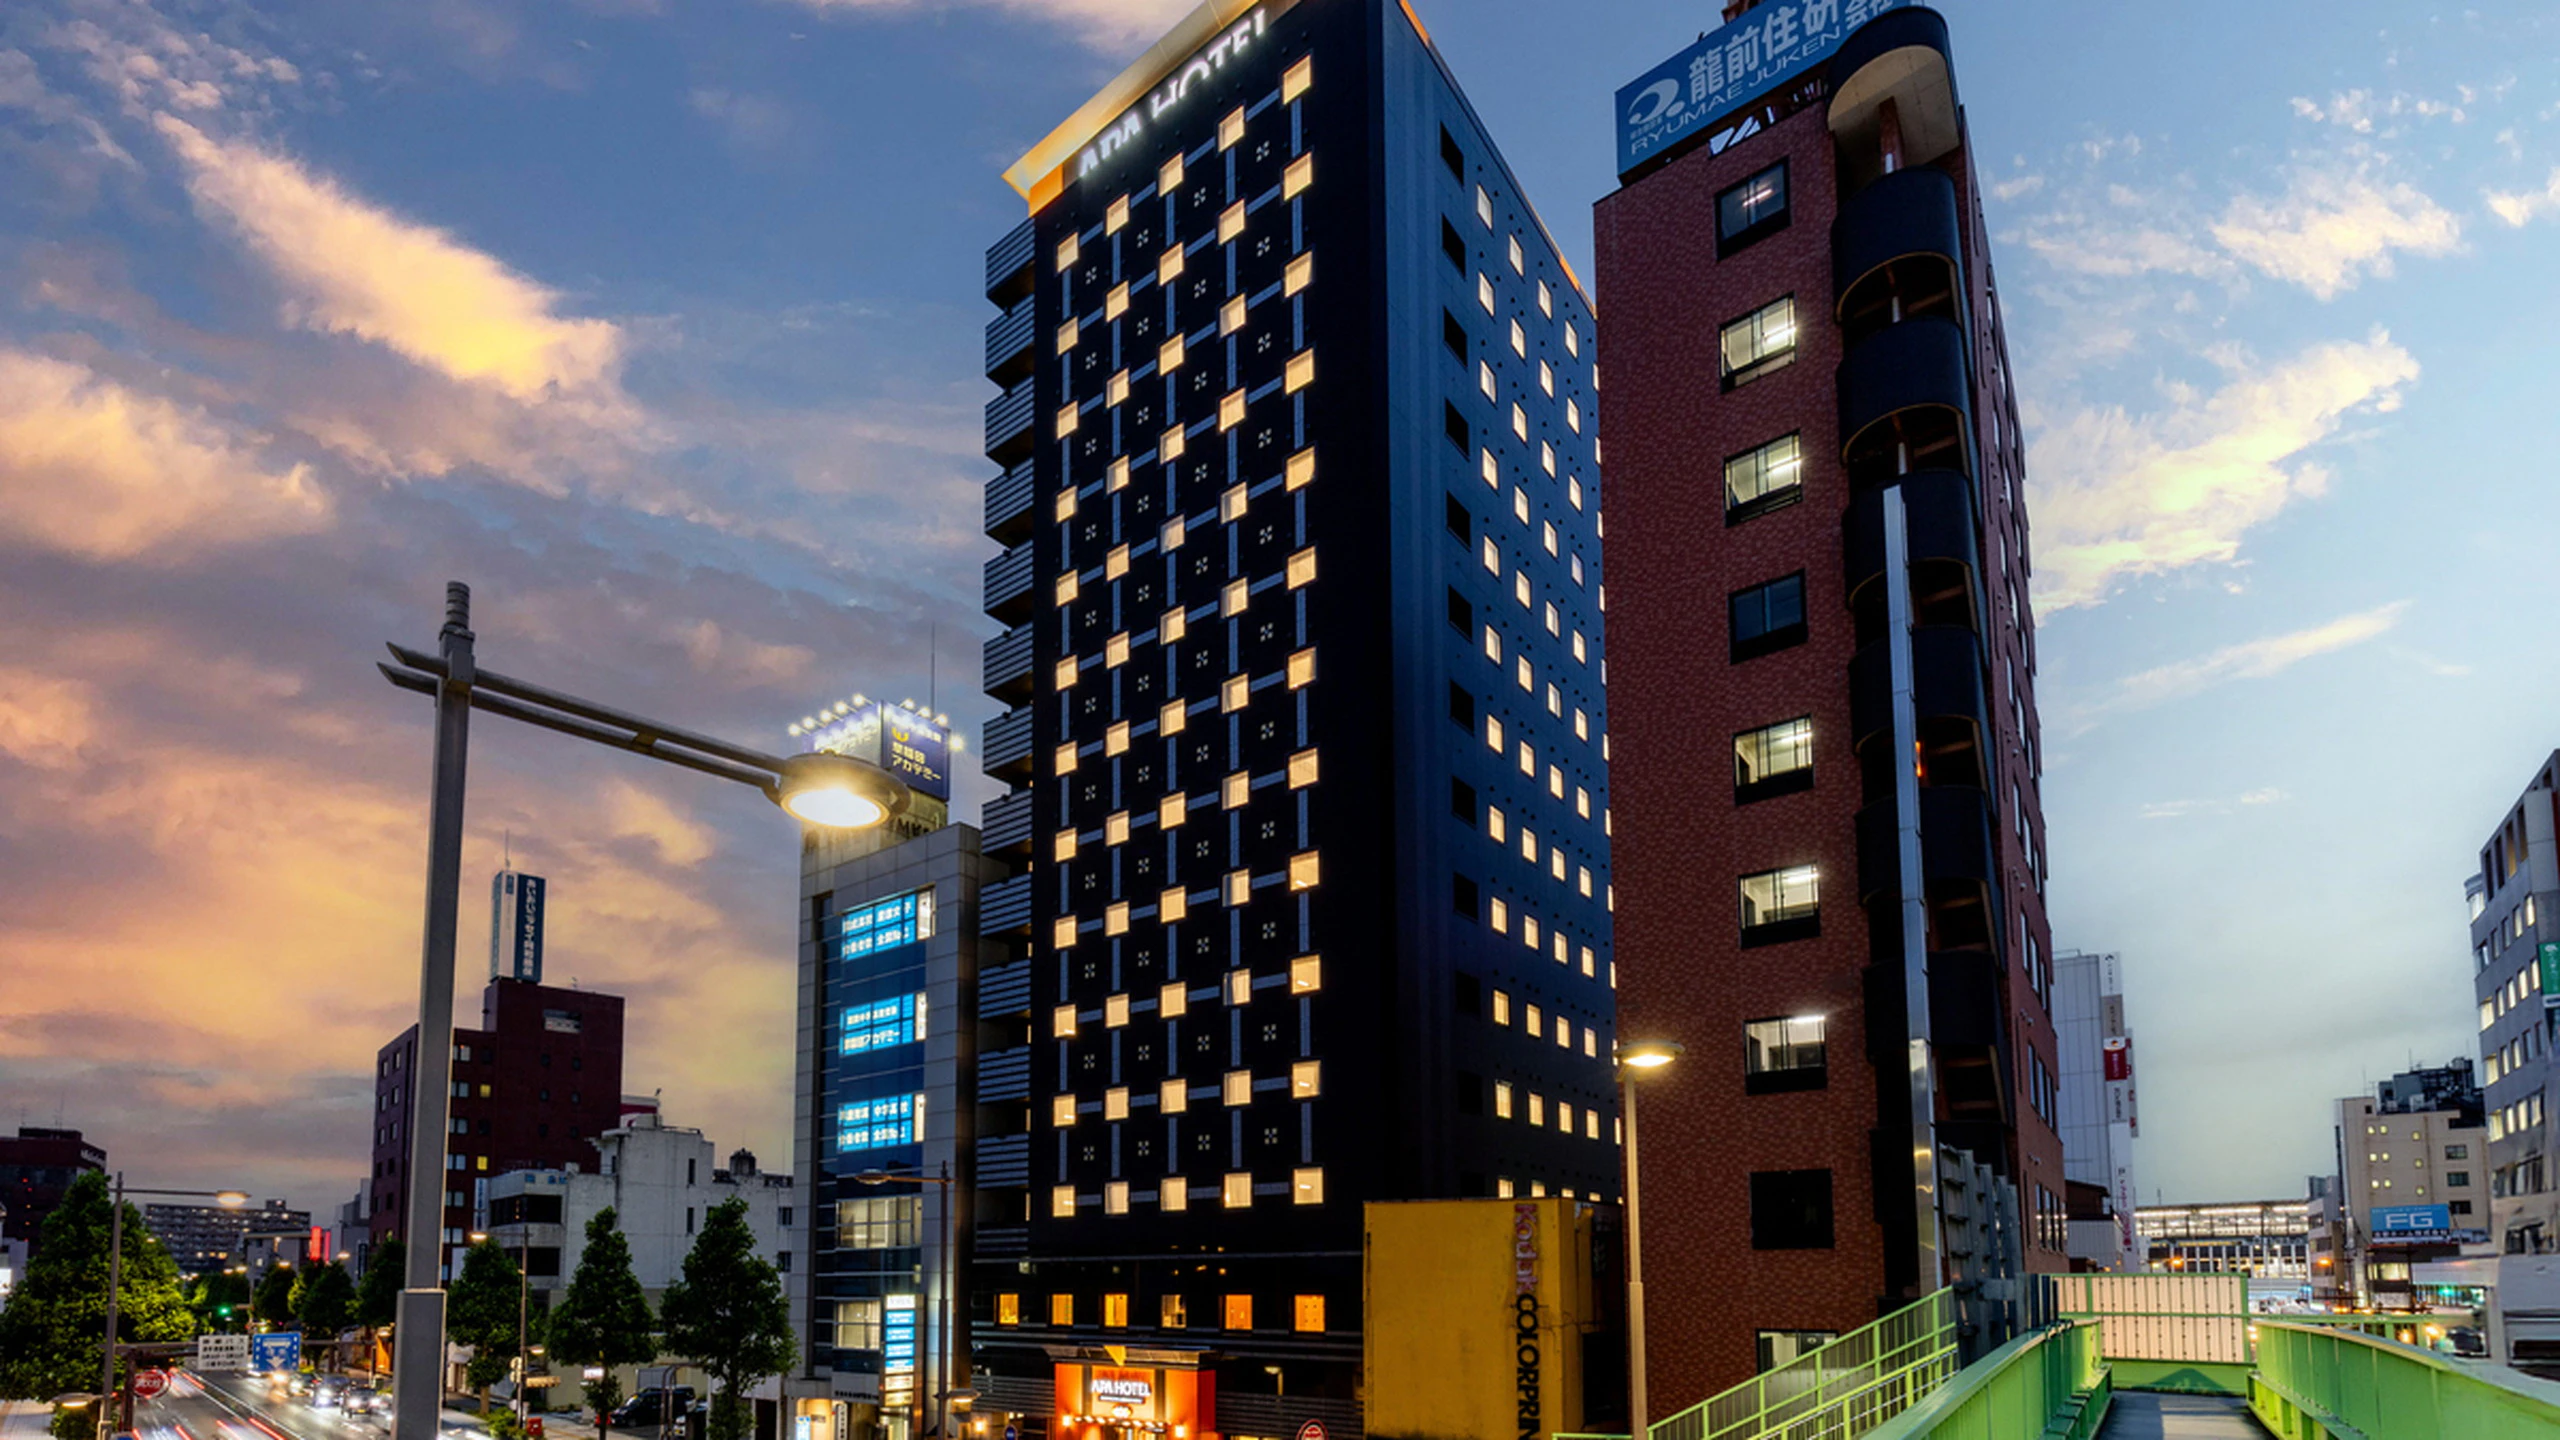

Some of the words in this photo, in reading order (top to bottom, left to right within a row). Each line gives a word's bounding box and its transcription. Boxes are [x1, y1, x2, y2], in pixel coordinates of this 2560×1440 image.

[1688, 0, 1840, 106] 龍前住研
[1630, 84, 1744, 157] RYUMAE
[1748, 25, 1842, 88] JUKEN
[892, 754, 941, 780] アカデミー
[1514, 1203, 1539, 1295] Kodak
[2385, 1211, 2434, 1230] FG
[1091, 1379, 1113, 1394] APA
[1114, 1380, 1151, 1397] HOTEL
